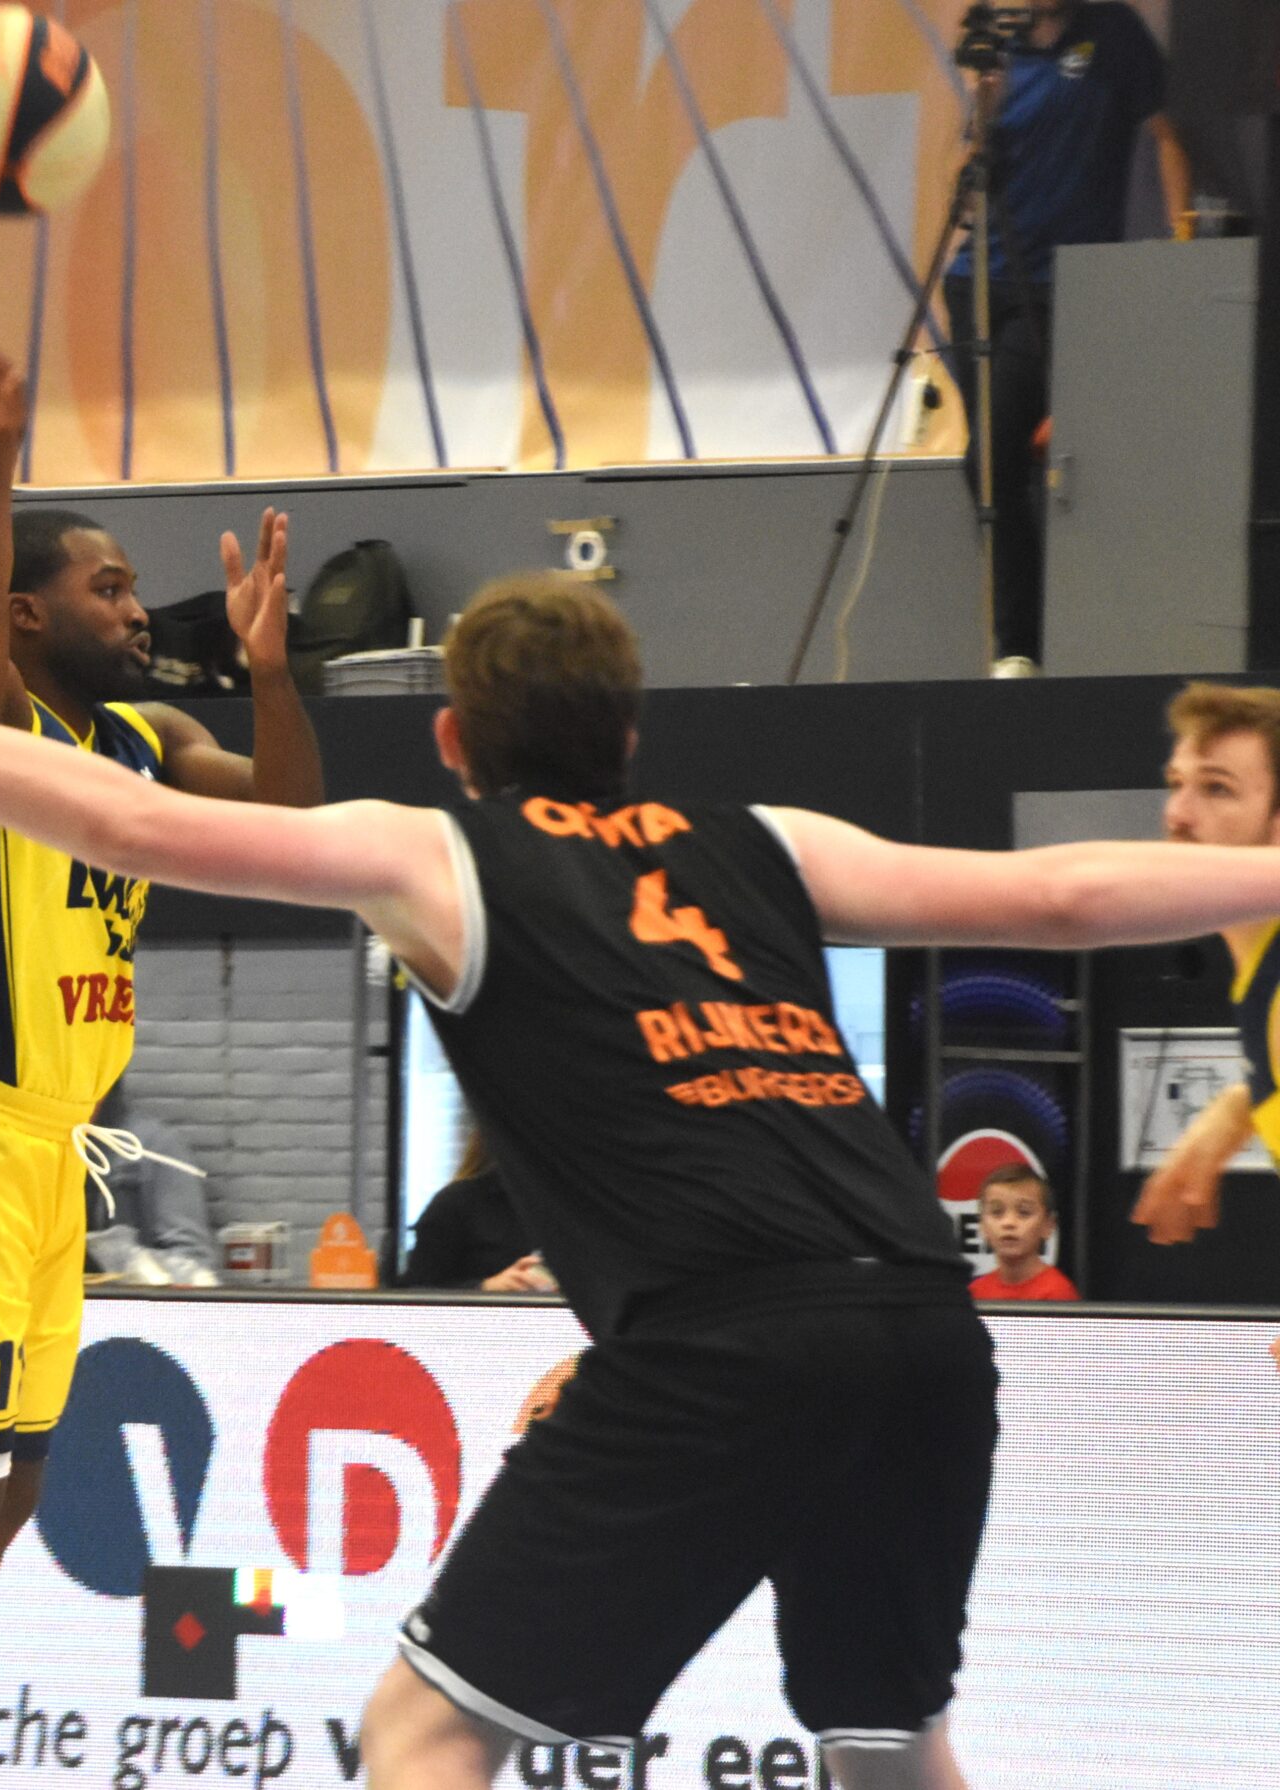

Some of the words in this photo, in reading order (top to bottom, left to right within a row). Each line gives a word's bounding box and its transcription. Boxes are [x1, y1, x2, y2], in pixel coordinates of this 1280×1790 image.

[629, 868, 744, 982] 4
[57, 972, 135, 1027] VRE
[635, 1001, 843, 1063] RIJKERS
[114, 1694, 293, 1790] groep
